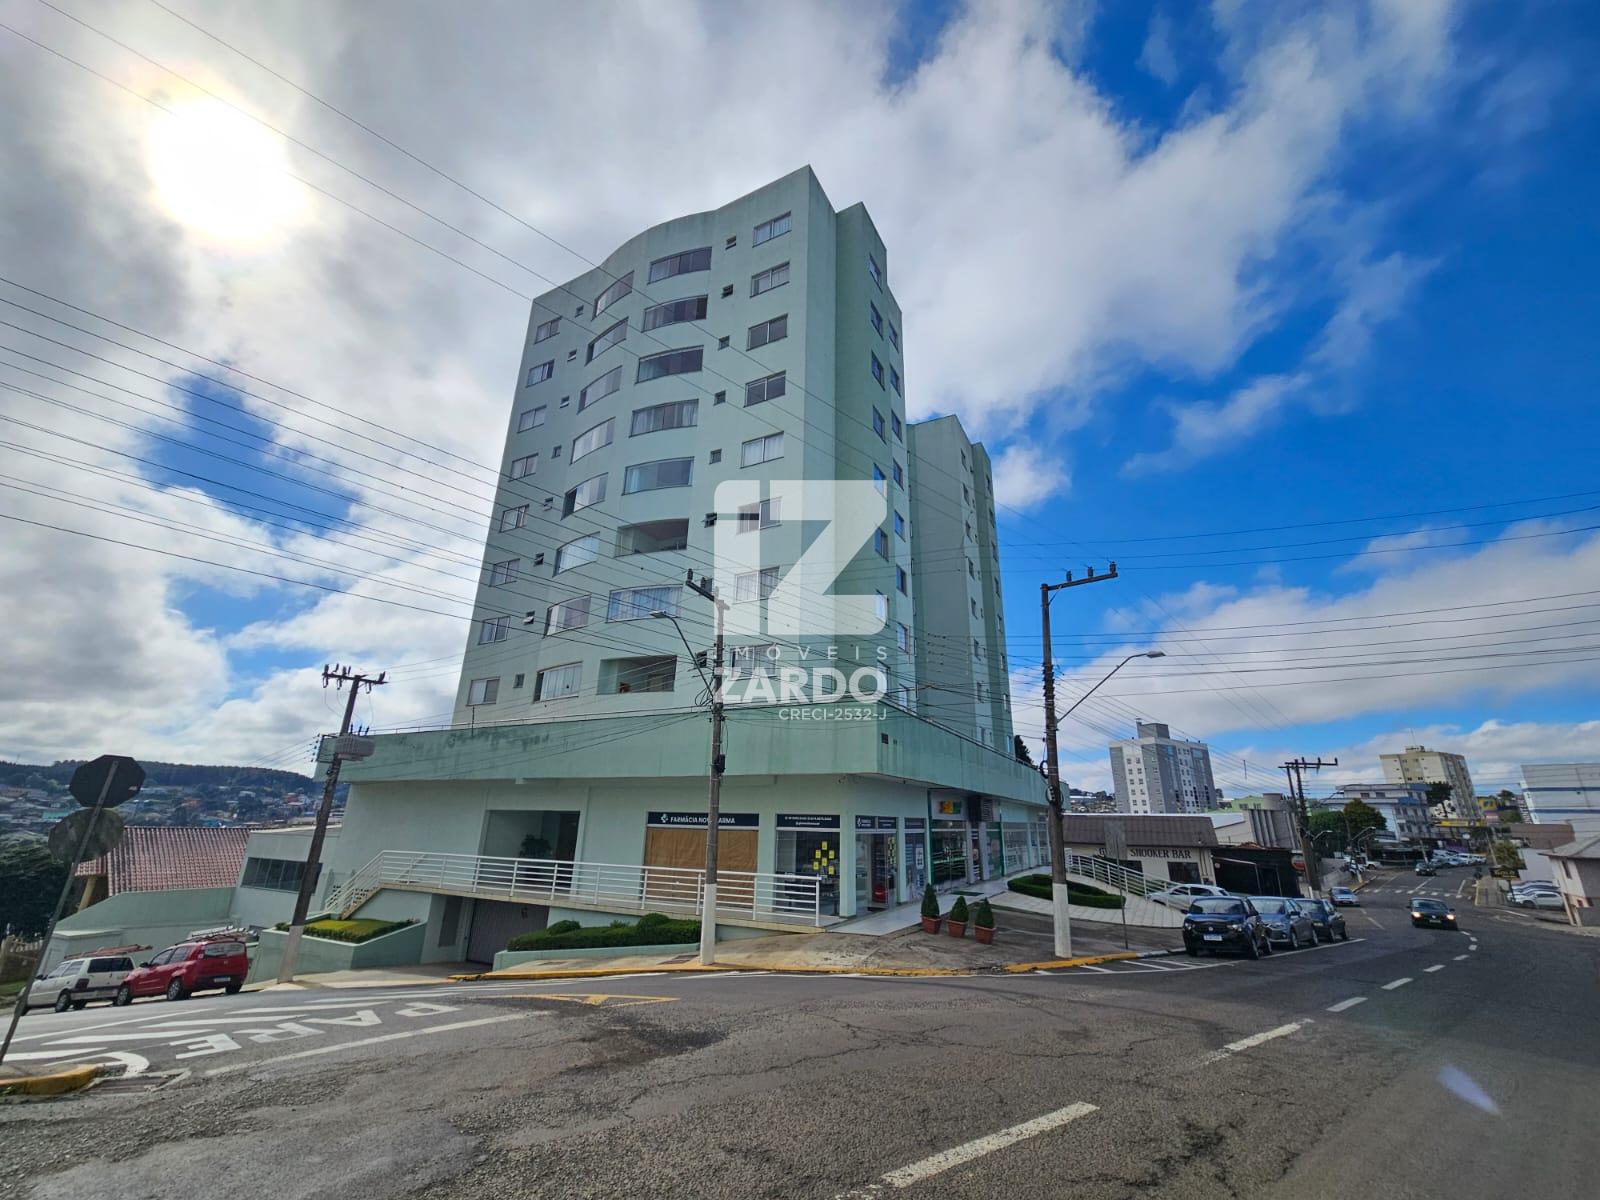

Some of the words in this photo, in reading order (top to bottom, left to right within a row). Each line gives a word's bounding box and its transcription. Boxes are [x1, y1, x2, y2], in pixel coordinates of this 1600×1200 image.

[670, 815, 698, 824] FARMÁCIA
[1172, 849, 1192, 859] BAR
[169, 1001, 463, 1060] PARE
